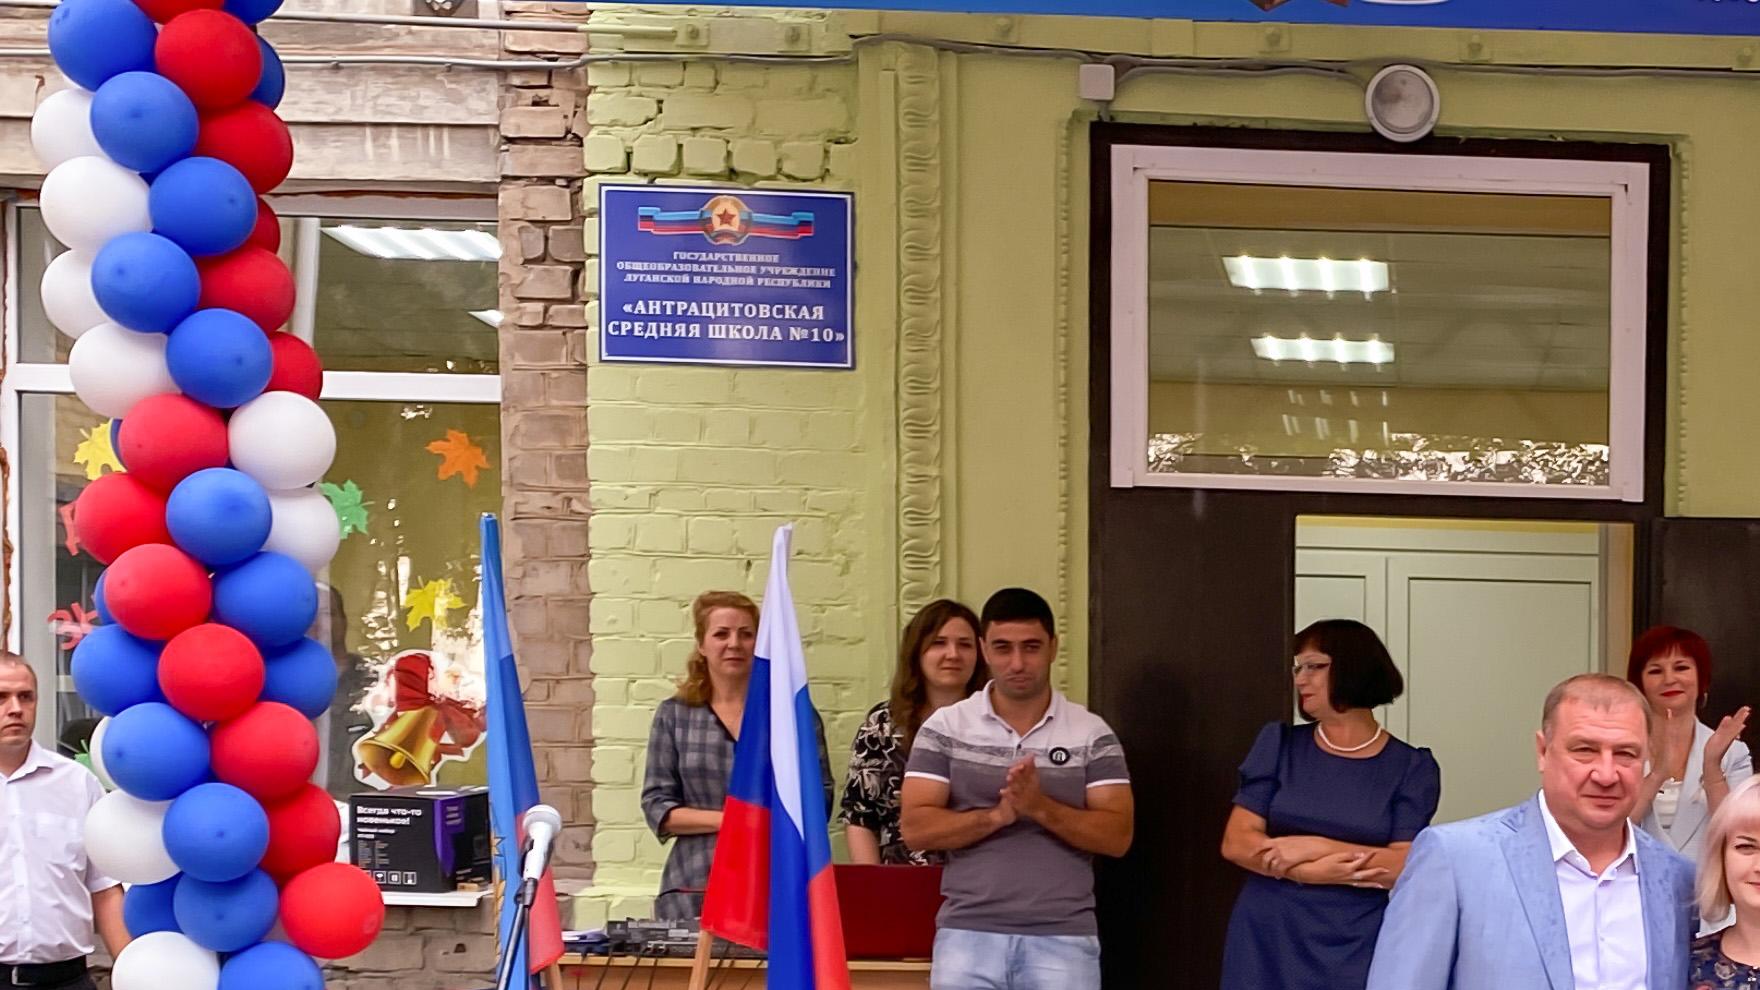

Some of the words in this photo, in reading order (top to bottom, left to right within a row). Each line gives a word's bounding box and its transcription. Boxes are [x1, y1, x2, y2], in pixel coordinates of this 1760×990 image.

[673, 251, 780, 263] ГОСУДАРСТВЕННОЕ
[616, 261, 757, 274] ОБЩЕОБРАЗОВАТЕЛЬНОЕ
[760, 266, 836, 277] УЧРЕЖДЕНИЕ
[623, 273, 690, 284] ЛУГАНСКОЙ
[693, 275, 754, 286] НАРОДНОЙ
[757, 277, 831, 288] РЕСПУБЛИКИ
[622, 300, 825, 320] «АНТРАЦИТОВСКАЯ
[607, 320, 701, 340] СРЕДНЯЯ
[708, 324, 783, 341] ШКОЛА
[789, 326, 845, 342] №10»
